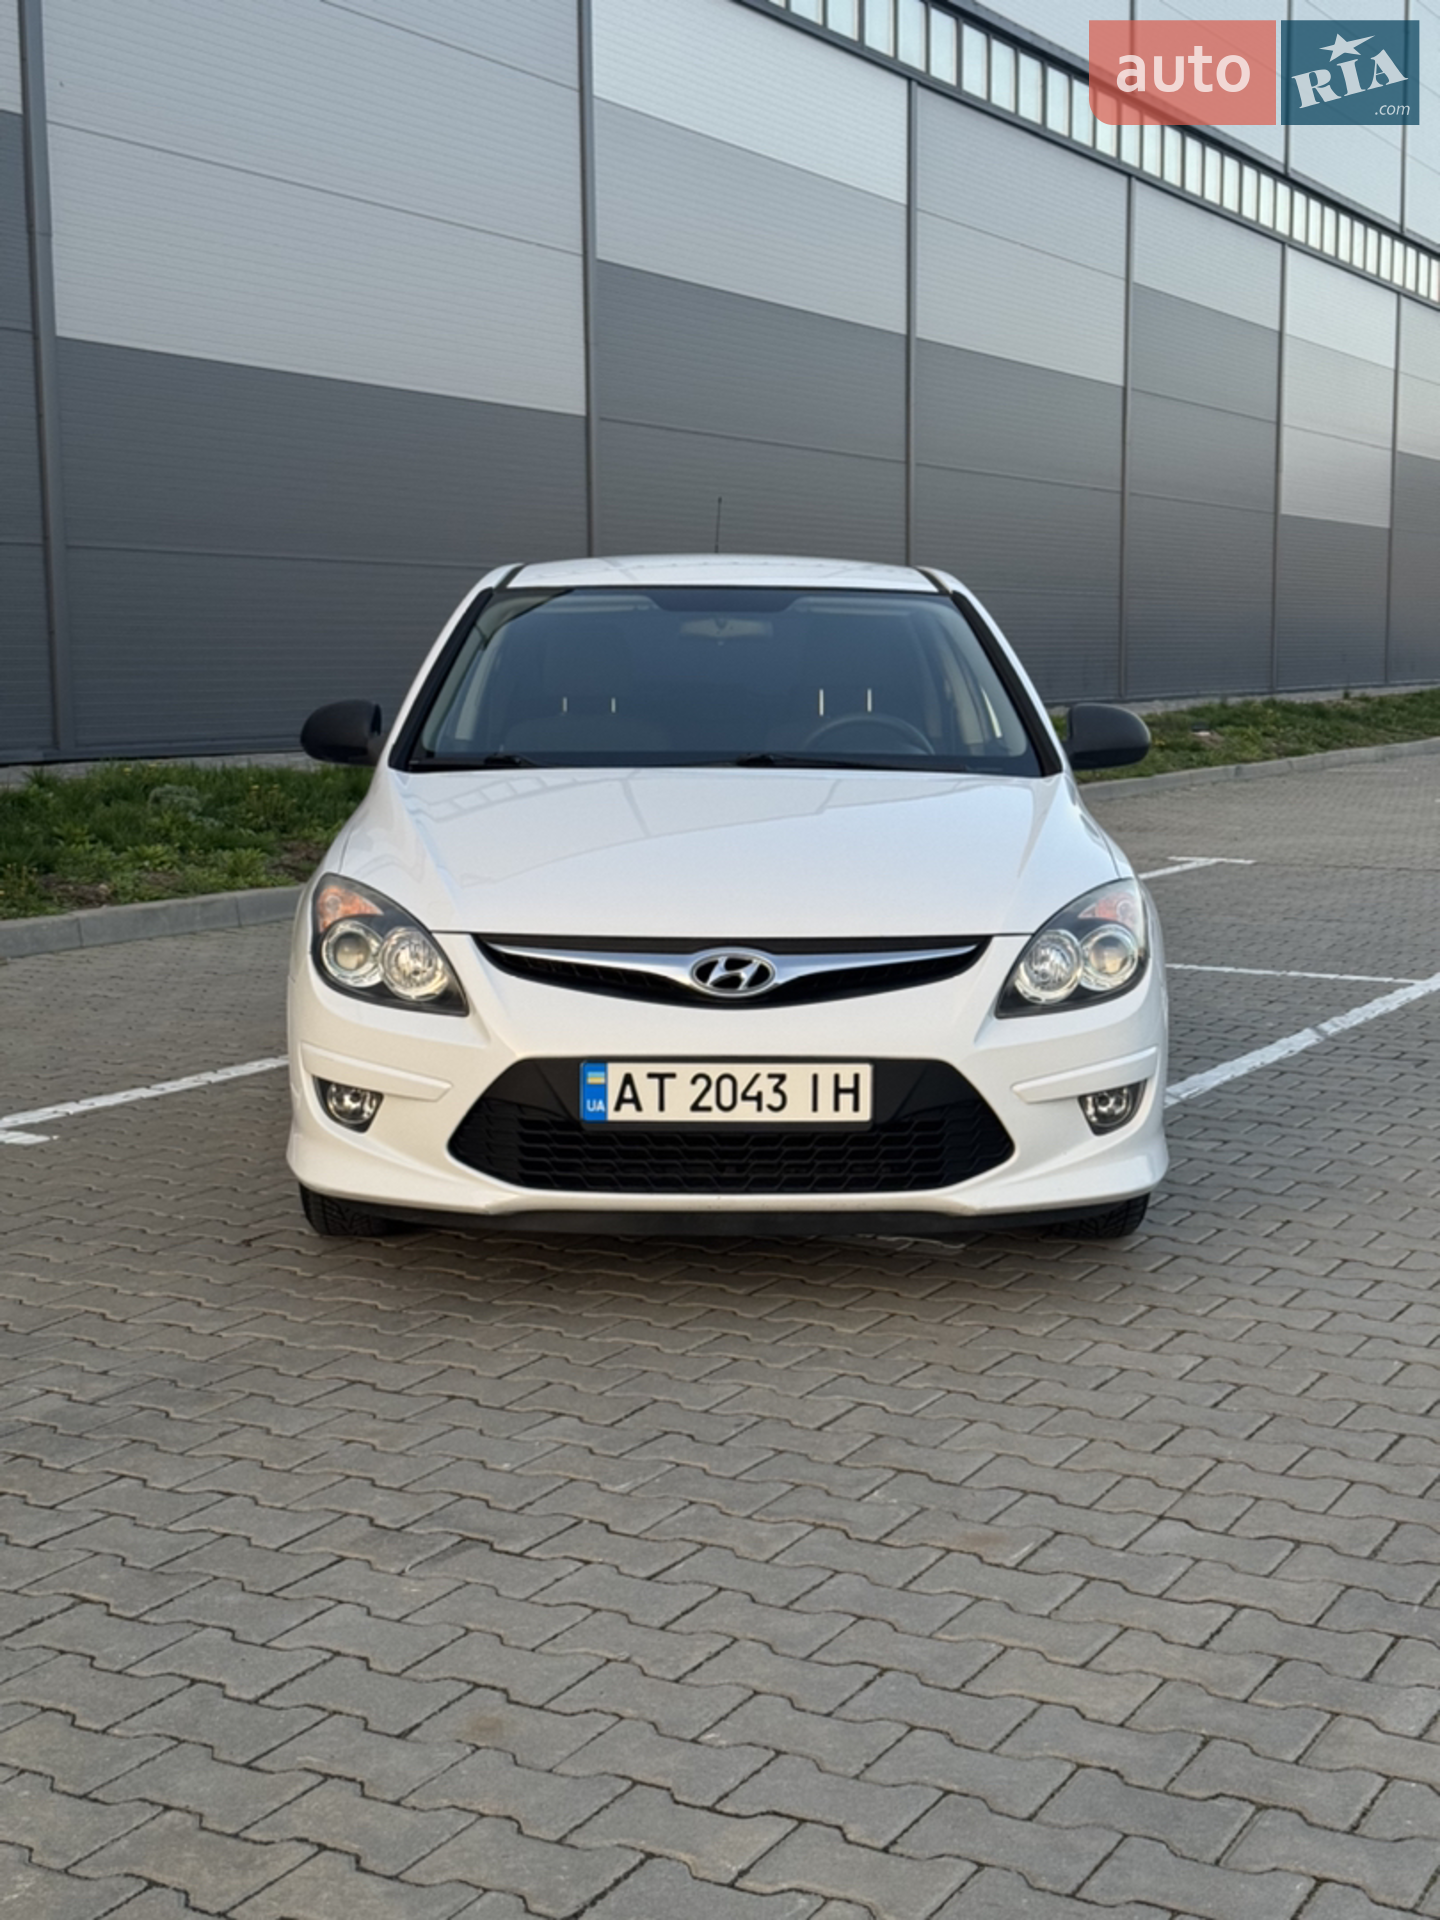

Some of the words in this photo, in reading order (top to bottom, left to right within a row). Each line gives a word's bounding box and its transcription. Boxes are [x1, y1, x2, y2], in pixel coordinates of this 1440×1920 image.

[586, 1099, 606, 1112] UA
[613, 1072, 677, 1112] AT
[690, 1073, 787, 1112] 2043
[811, 1073, 860, 1113] IH
